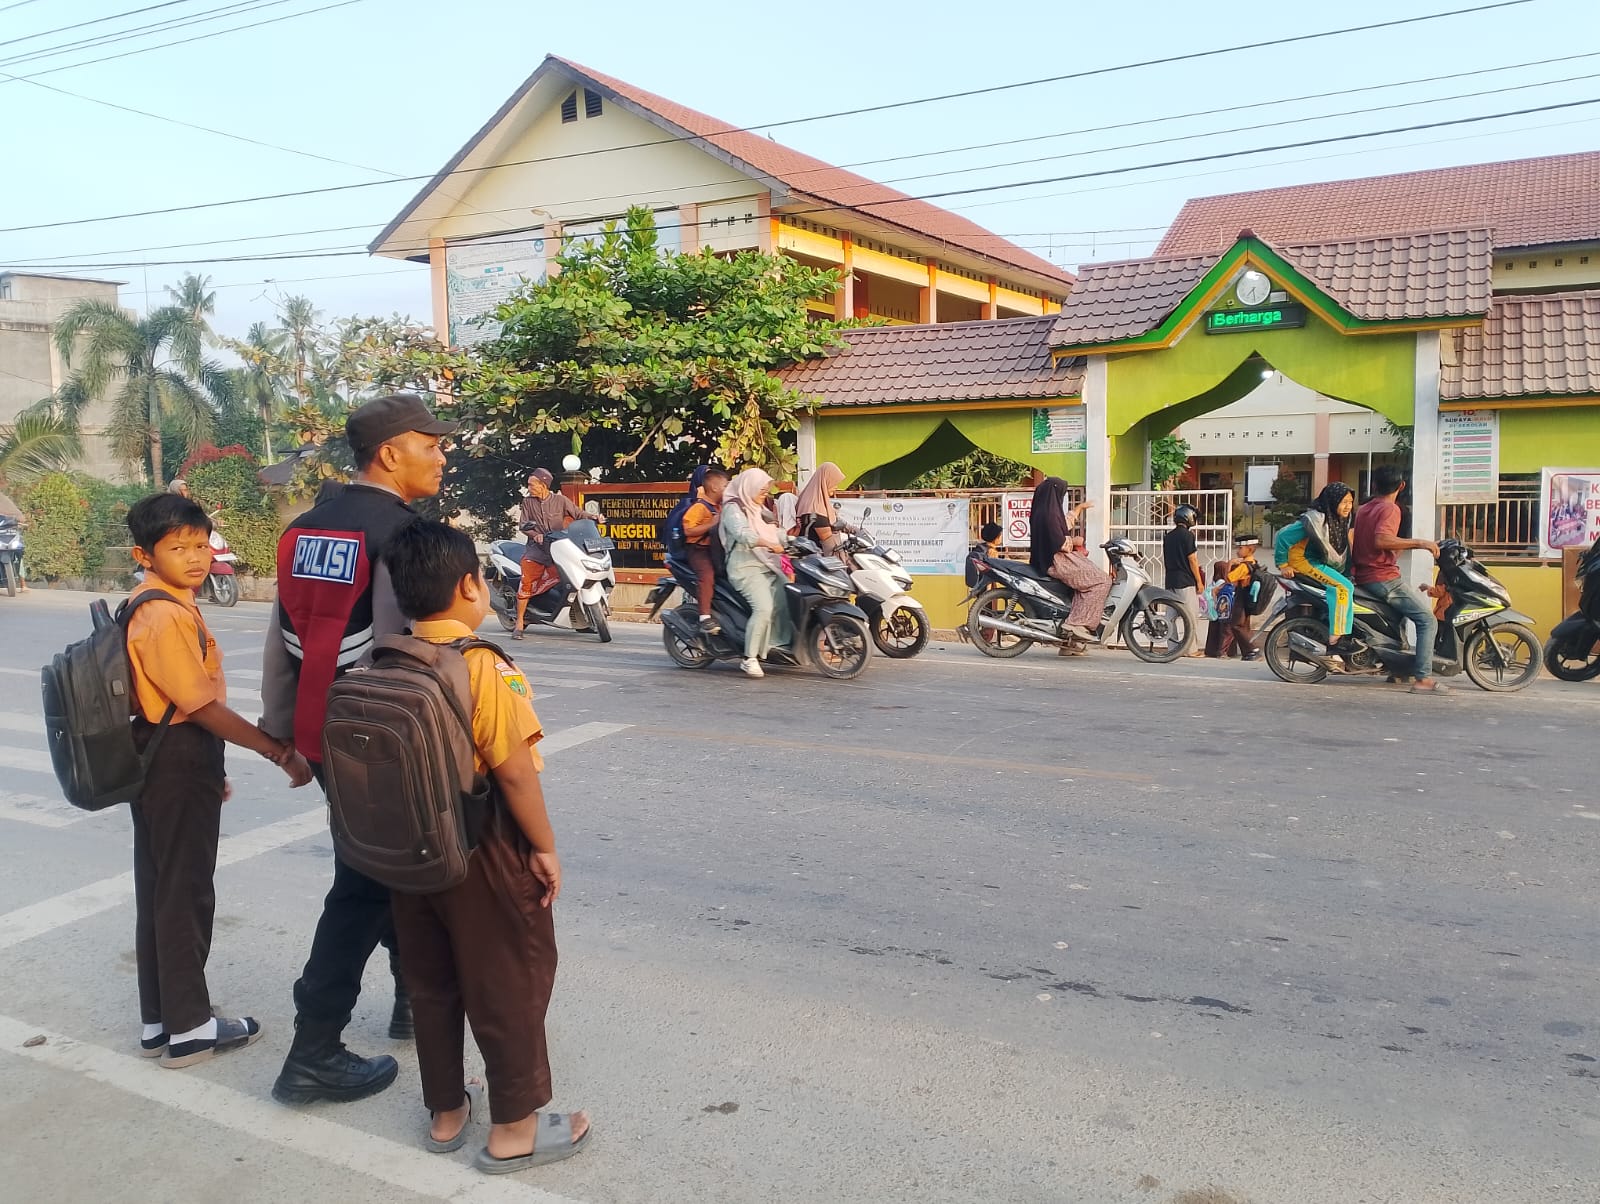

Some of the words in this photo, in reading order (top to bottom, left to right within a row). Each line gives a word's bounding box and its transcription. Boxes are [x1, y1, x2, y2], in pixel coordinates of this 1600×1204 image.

[1213, 311, 1282, 326] Berharga
[602, 498, 651, 509] PEMERINTAH
[606, 509, 630, 518] DINAS
[610, 524, 656, 539] NEGERI
[294, 539, 355, 579] POLISI
